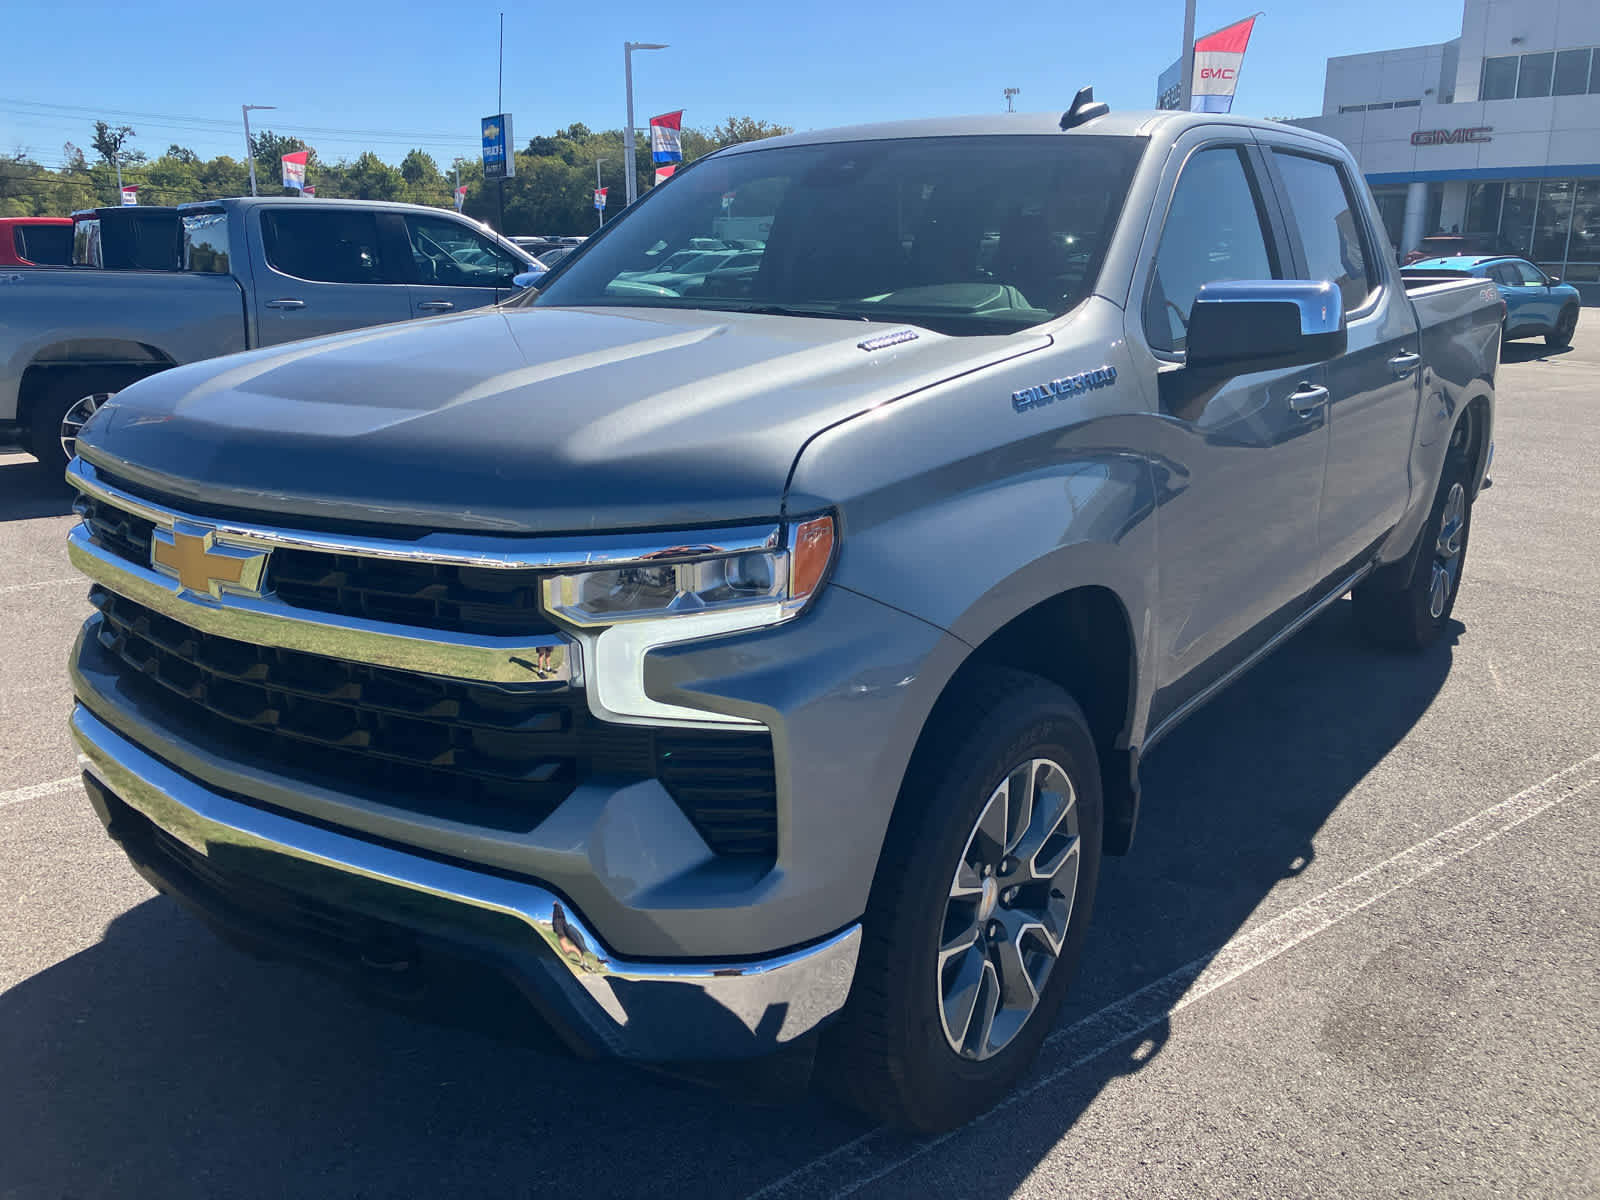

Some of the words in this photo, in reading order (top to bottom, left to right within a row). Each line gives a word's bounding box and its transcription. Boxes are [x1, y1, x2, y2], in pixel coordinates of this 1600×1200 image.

[1200, 68, 1235, 79] GMC
[1410, 126, 1493, 146] GMC
[1012, 365, 1118, 409] SILVERADO
